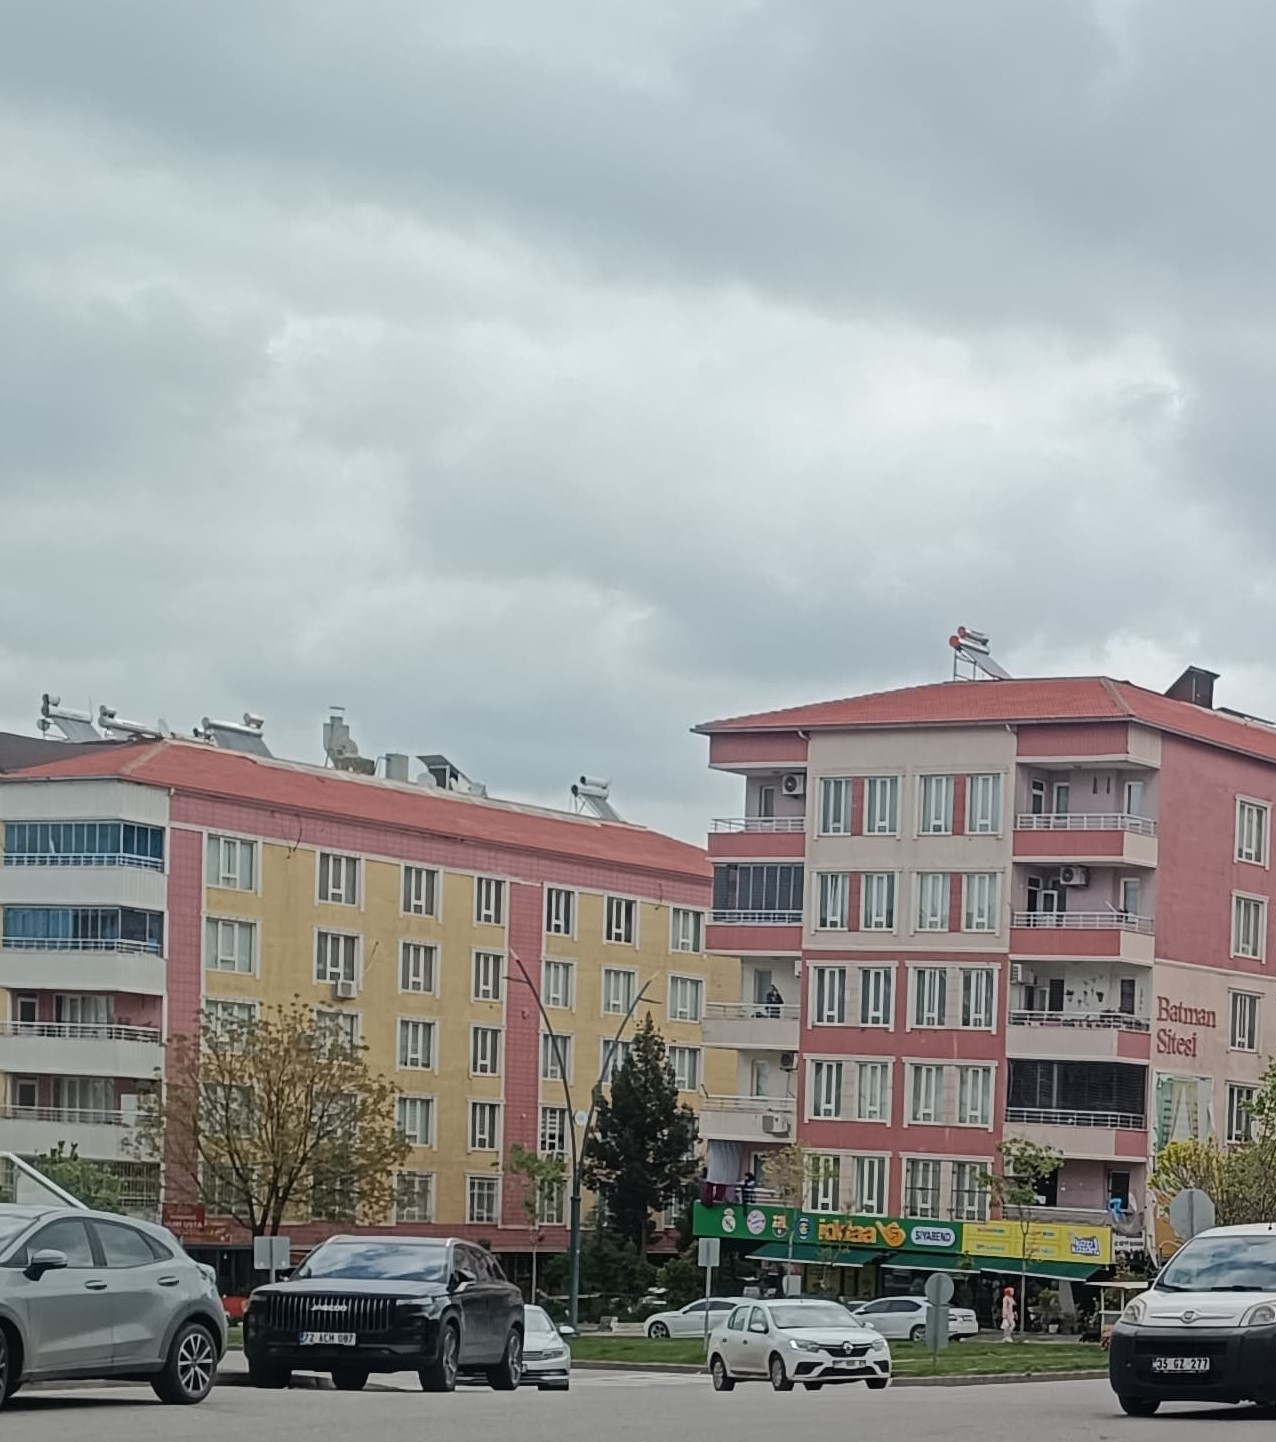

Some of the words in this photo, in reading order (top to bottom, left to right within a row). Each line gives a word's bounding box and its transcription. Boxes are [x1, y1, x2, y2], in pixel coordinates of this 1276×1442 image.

[1157, 995, 1216, 1028] Batman
[1157, 1028, 1197, 1057] Sitesi
[1191, 1359, 1208, 1369] 277
